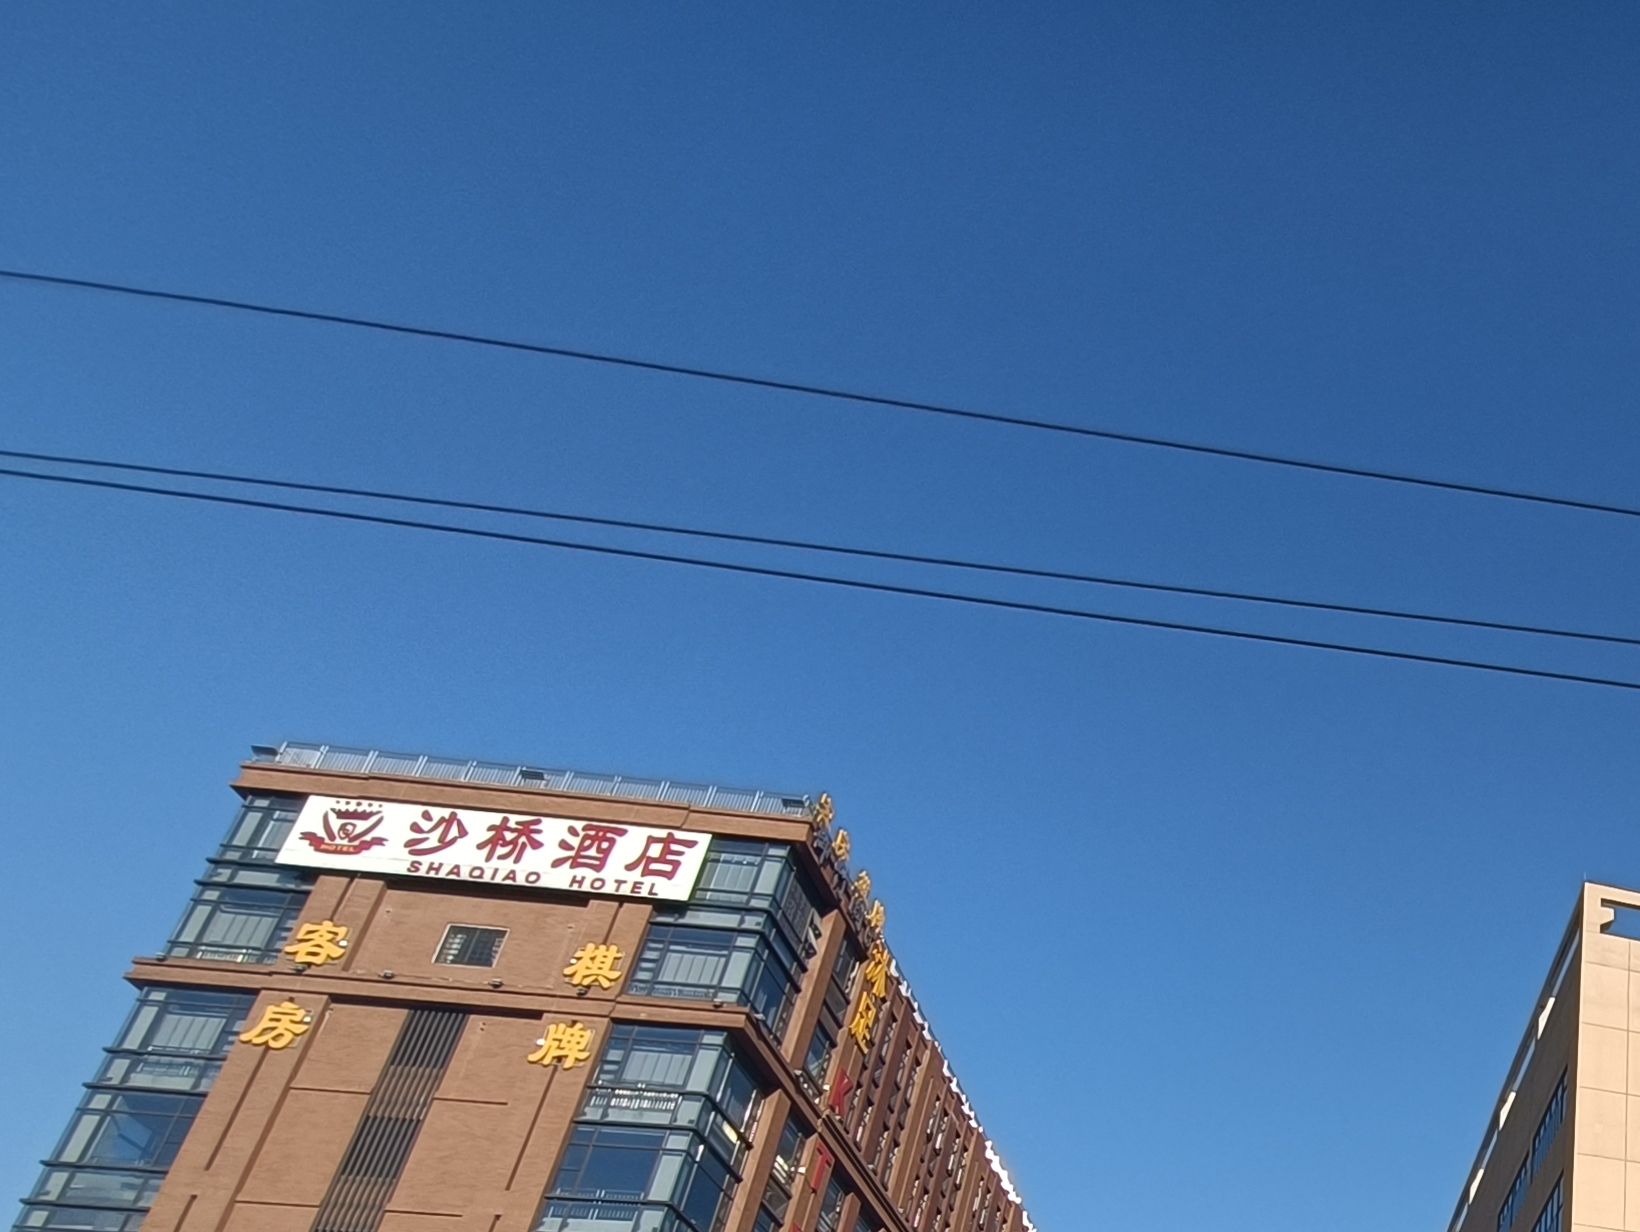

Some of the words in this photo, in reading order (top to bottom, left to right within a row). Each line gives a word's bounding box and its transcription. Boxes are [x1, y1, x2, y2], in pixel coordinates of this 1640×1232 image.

[403, 809, 699, 881] 沙桥酒店
[406, 860, 541, 885] SHAQIAO
[568, 874, 659, 897] HOTEL
